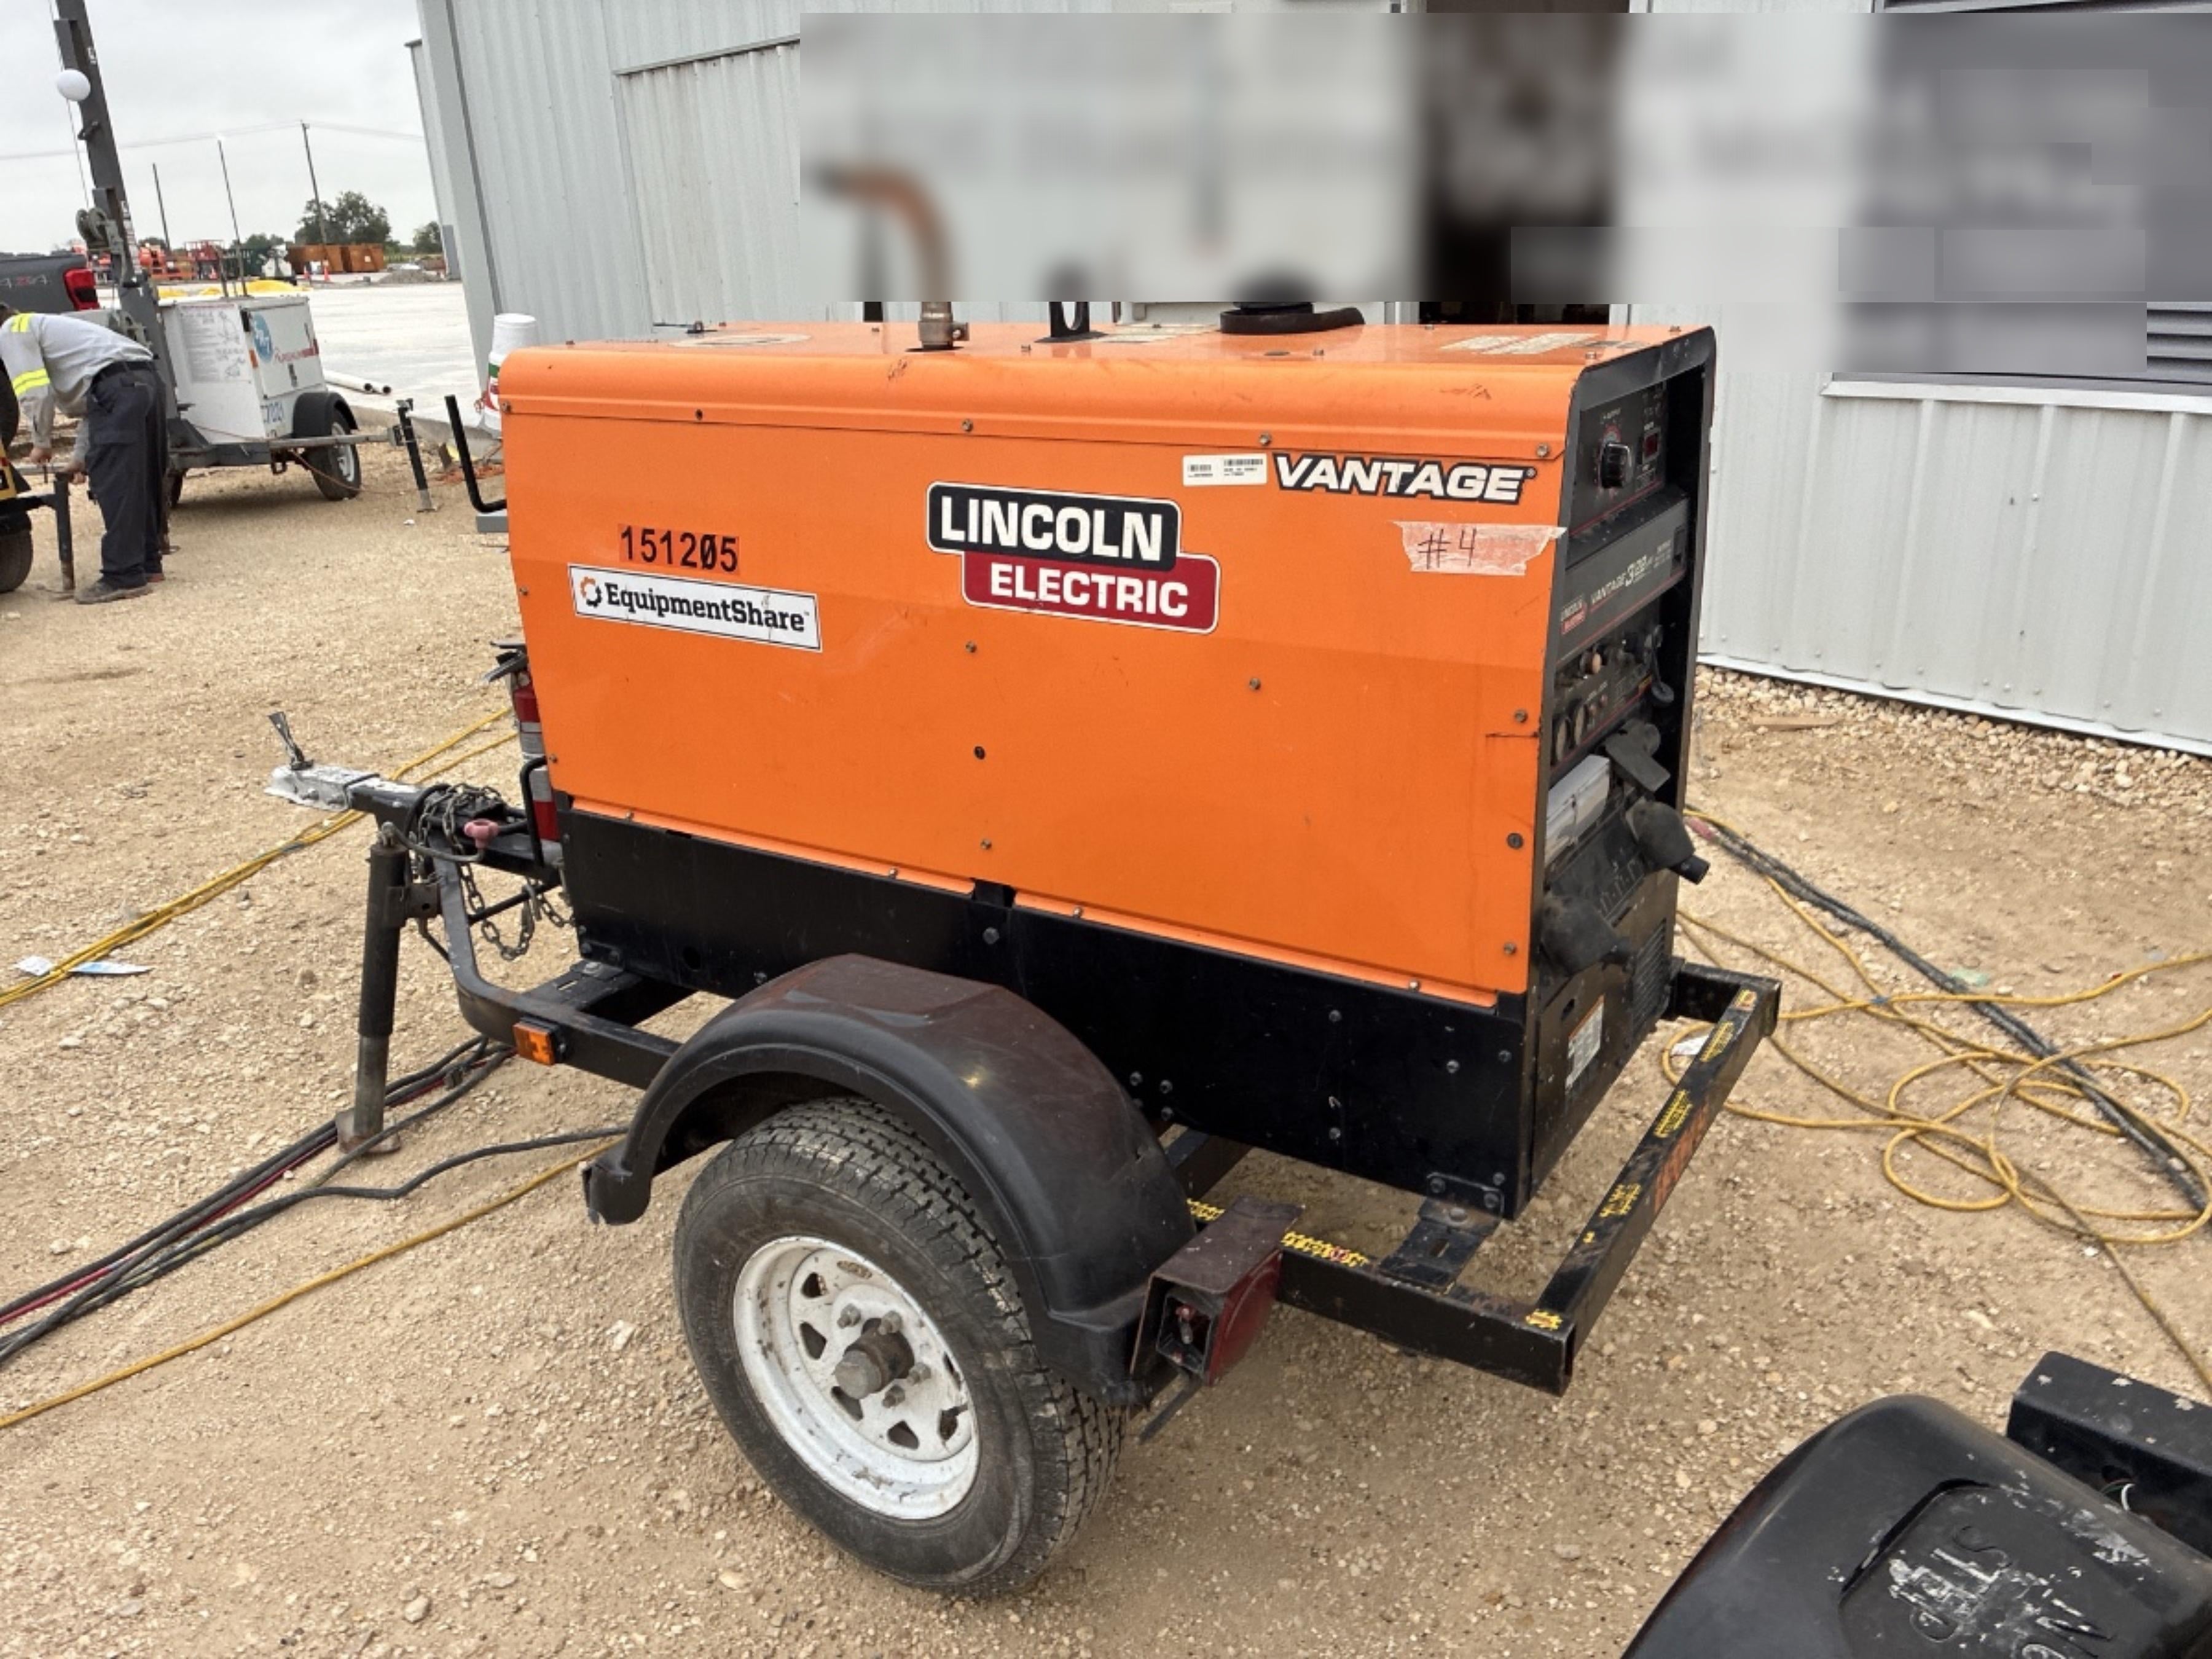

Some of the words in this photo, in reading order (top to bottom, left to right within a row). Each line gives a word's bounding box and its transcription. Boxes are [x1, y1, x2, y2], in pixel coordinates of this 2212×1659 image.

[1276, 455, 1524, 501] VANTAGE
[621, 525, 738, 573] 151205
[941, 495, 1163, 561] LINCOLN
[605, 582, 805, 633] EquipmentShare
[991, 562, 1189, 617] ELECTRIC
